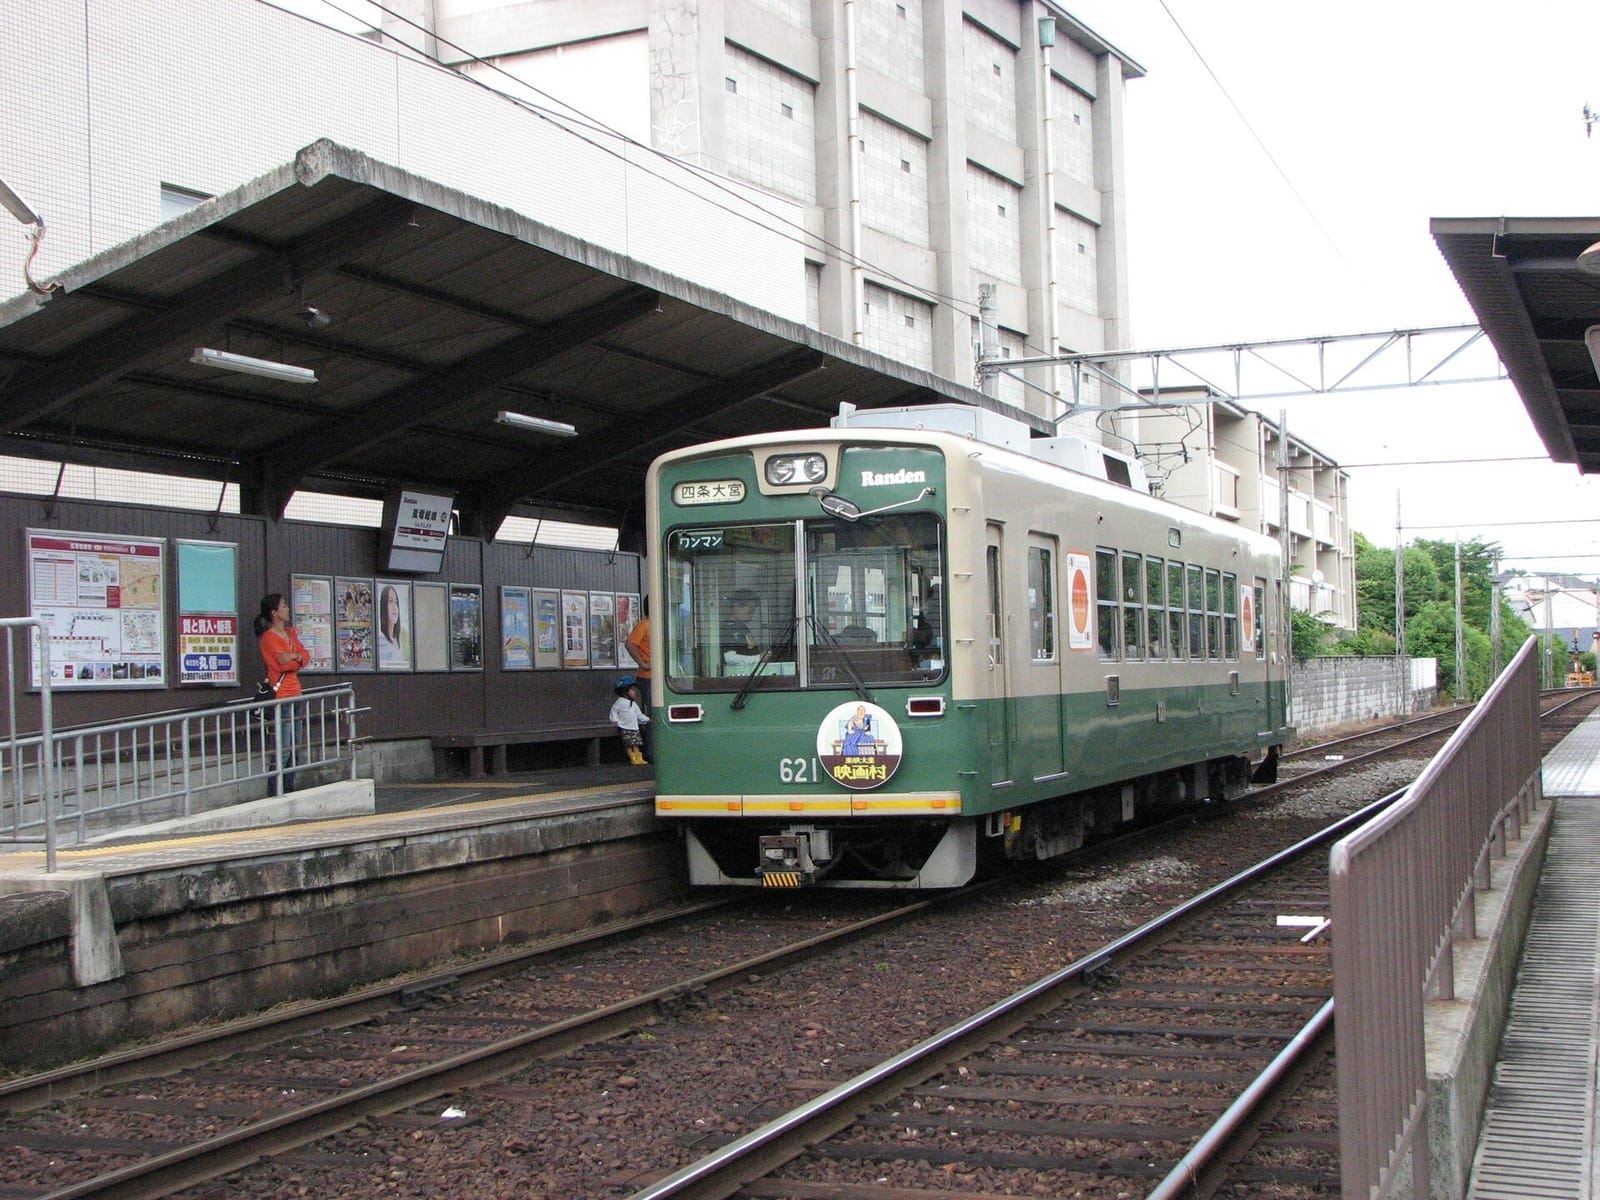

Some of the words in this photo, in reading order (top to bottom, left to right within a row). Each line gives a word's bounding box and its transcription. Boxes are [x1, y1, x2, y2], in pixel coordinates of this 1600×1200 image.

[861, 469, 925, 487] Randen
[681, 483, 742, 499] 四条大宮
[679, 536, 722, 549] ワンマン
[779, 757, 818, 783] 621
[833, 764, 886, 780] 映画村
